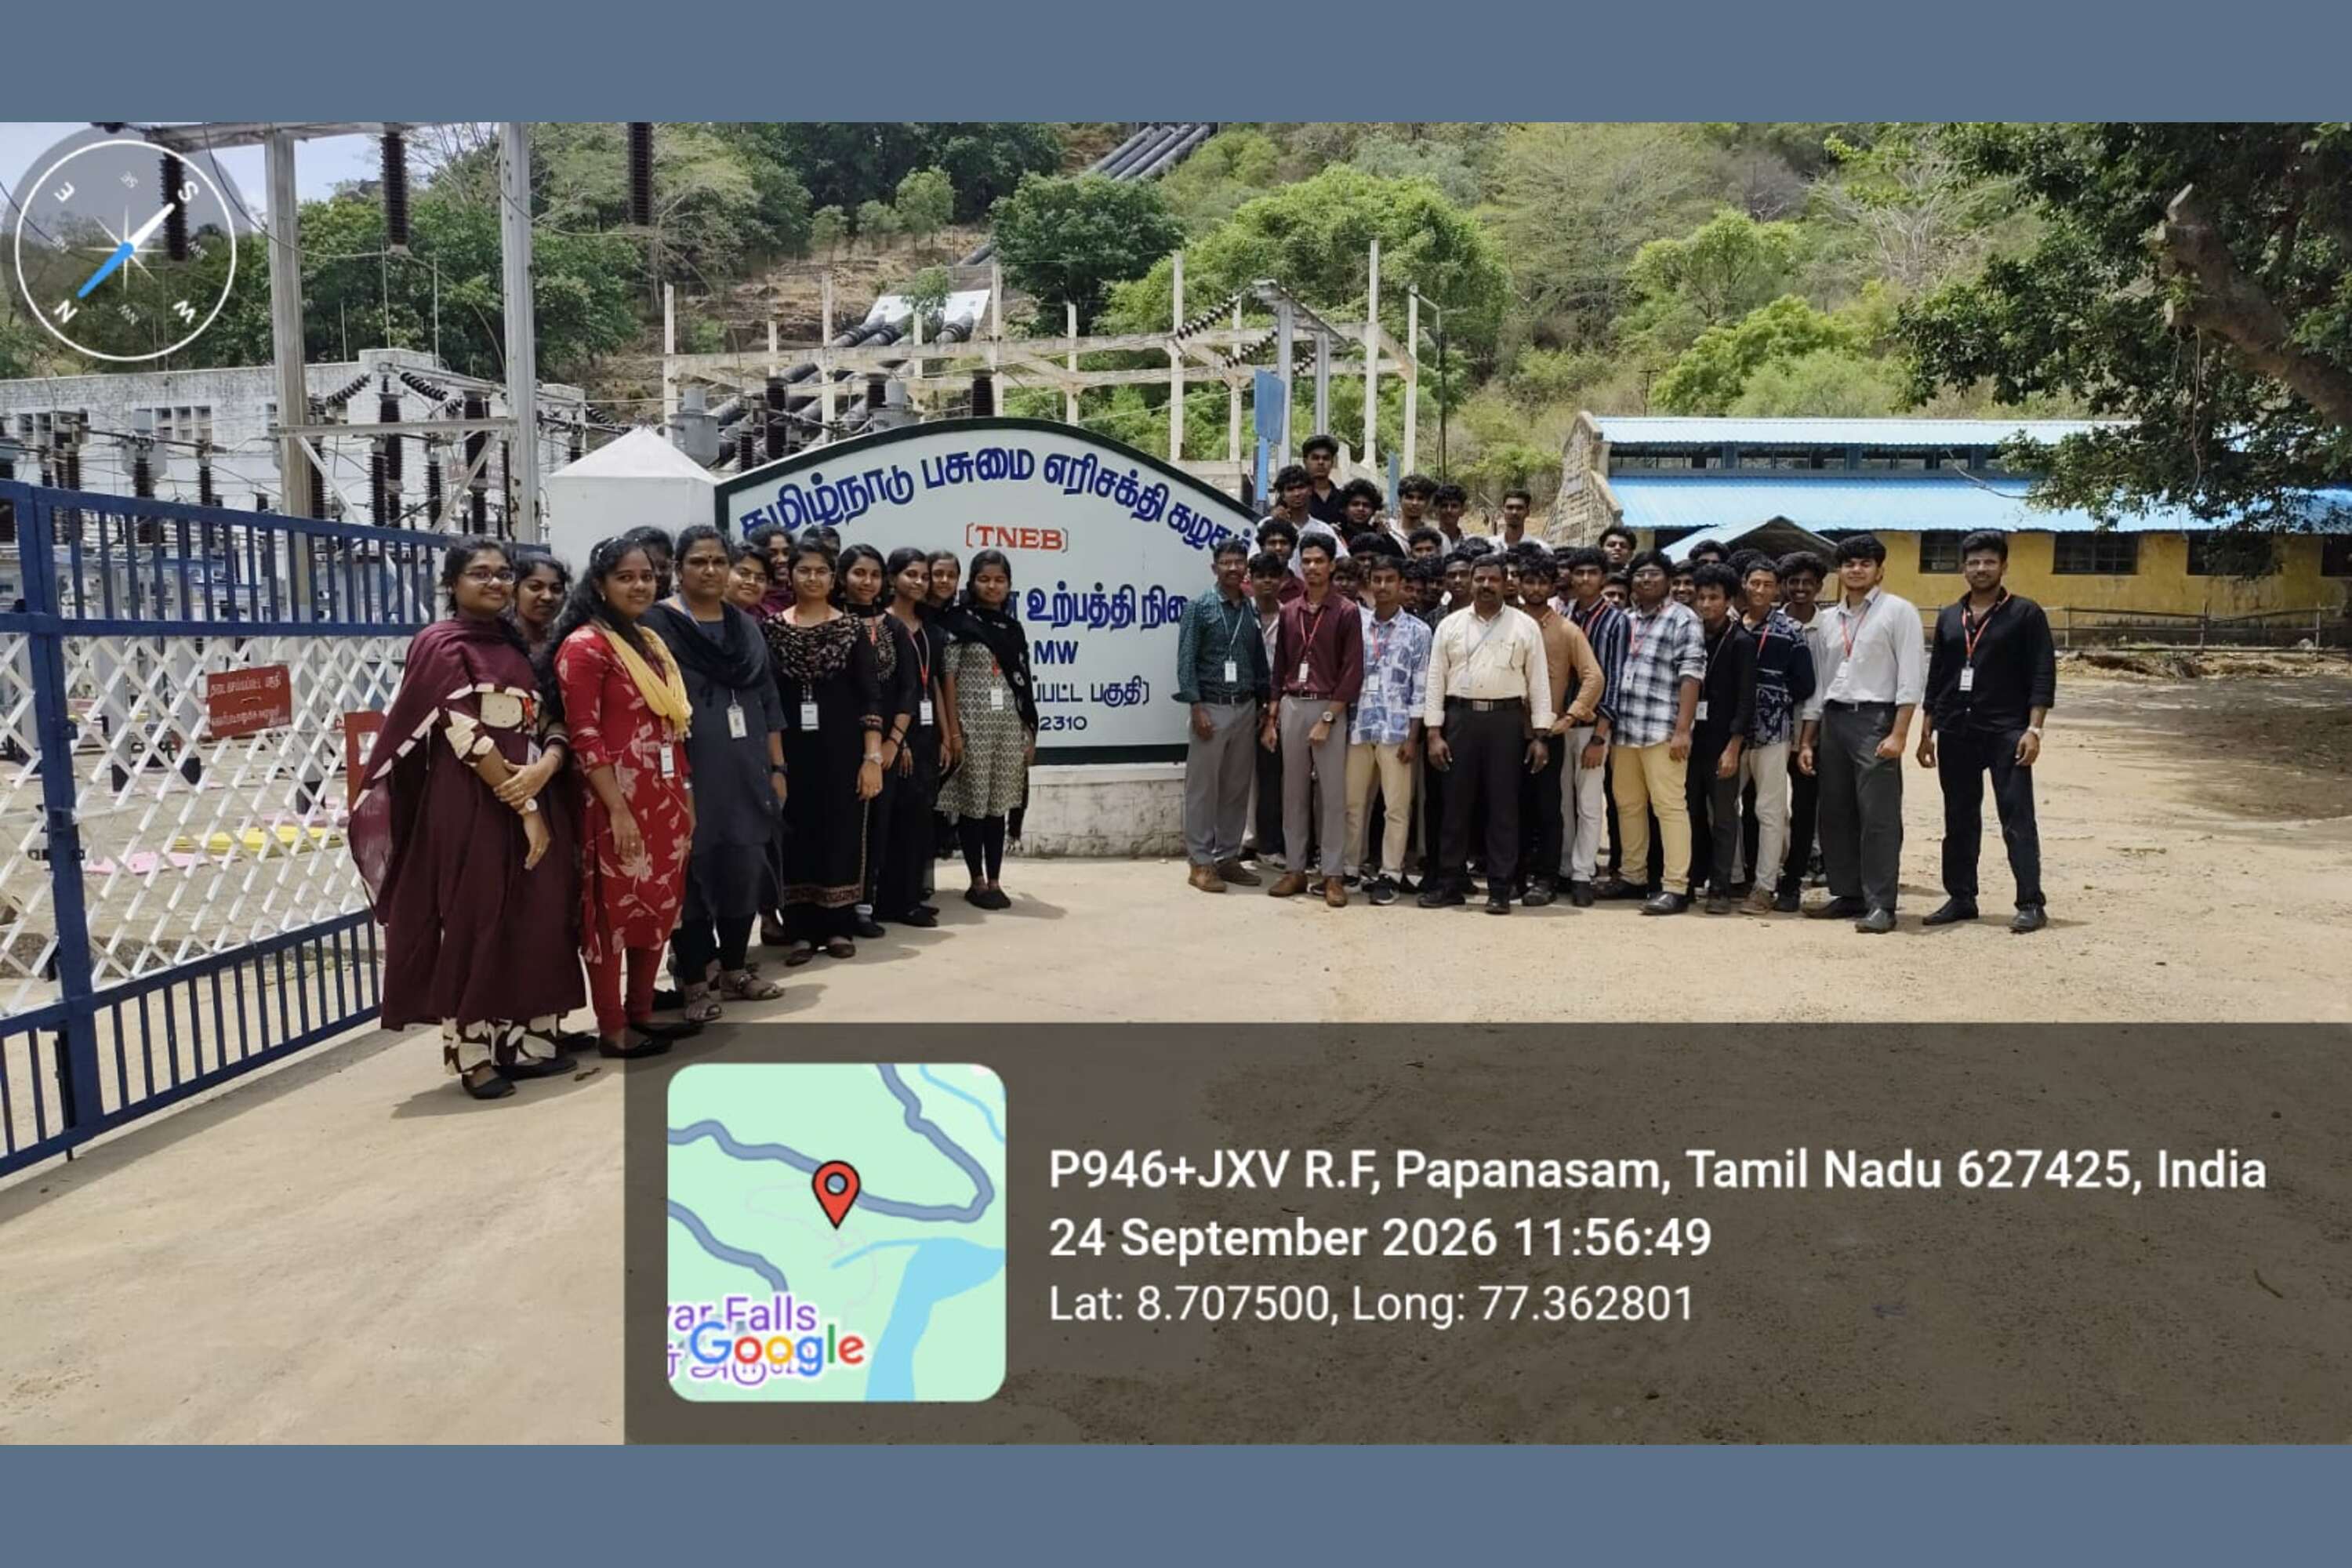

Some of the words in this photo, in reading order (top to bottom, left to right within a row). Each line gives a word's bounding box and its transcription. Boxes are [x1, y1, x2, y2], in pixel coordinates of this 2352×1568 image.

[920, 447, 1035, 489] பசுமை
[1044, 452, 1170, 522] எரிசக்தி
[1026, 581, 1137, 632] உற்பத்தி
[1034, 640, 1079, 664] MW
[1091, 674, 1149, 707] பகுதி)
